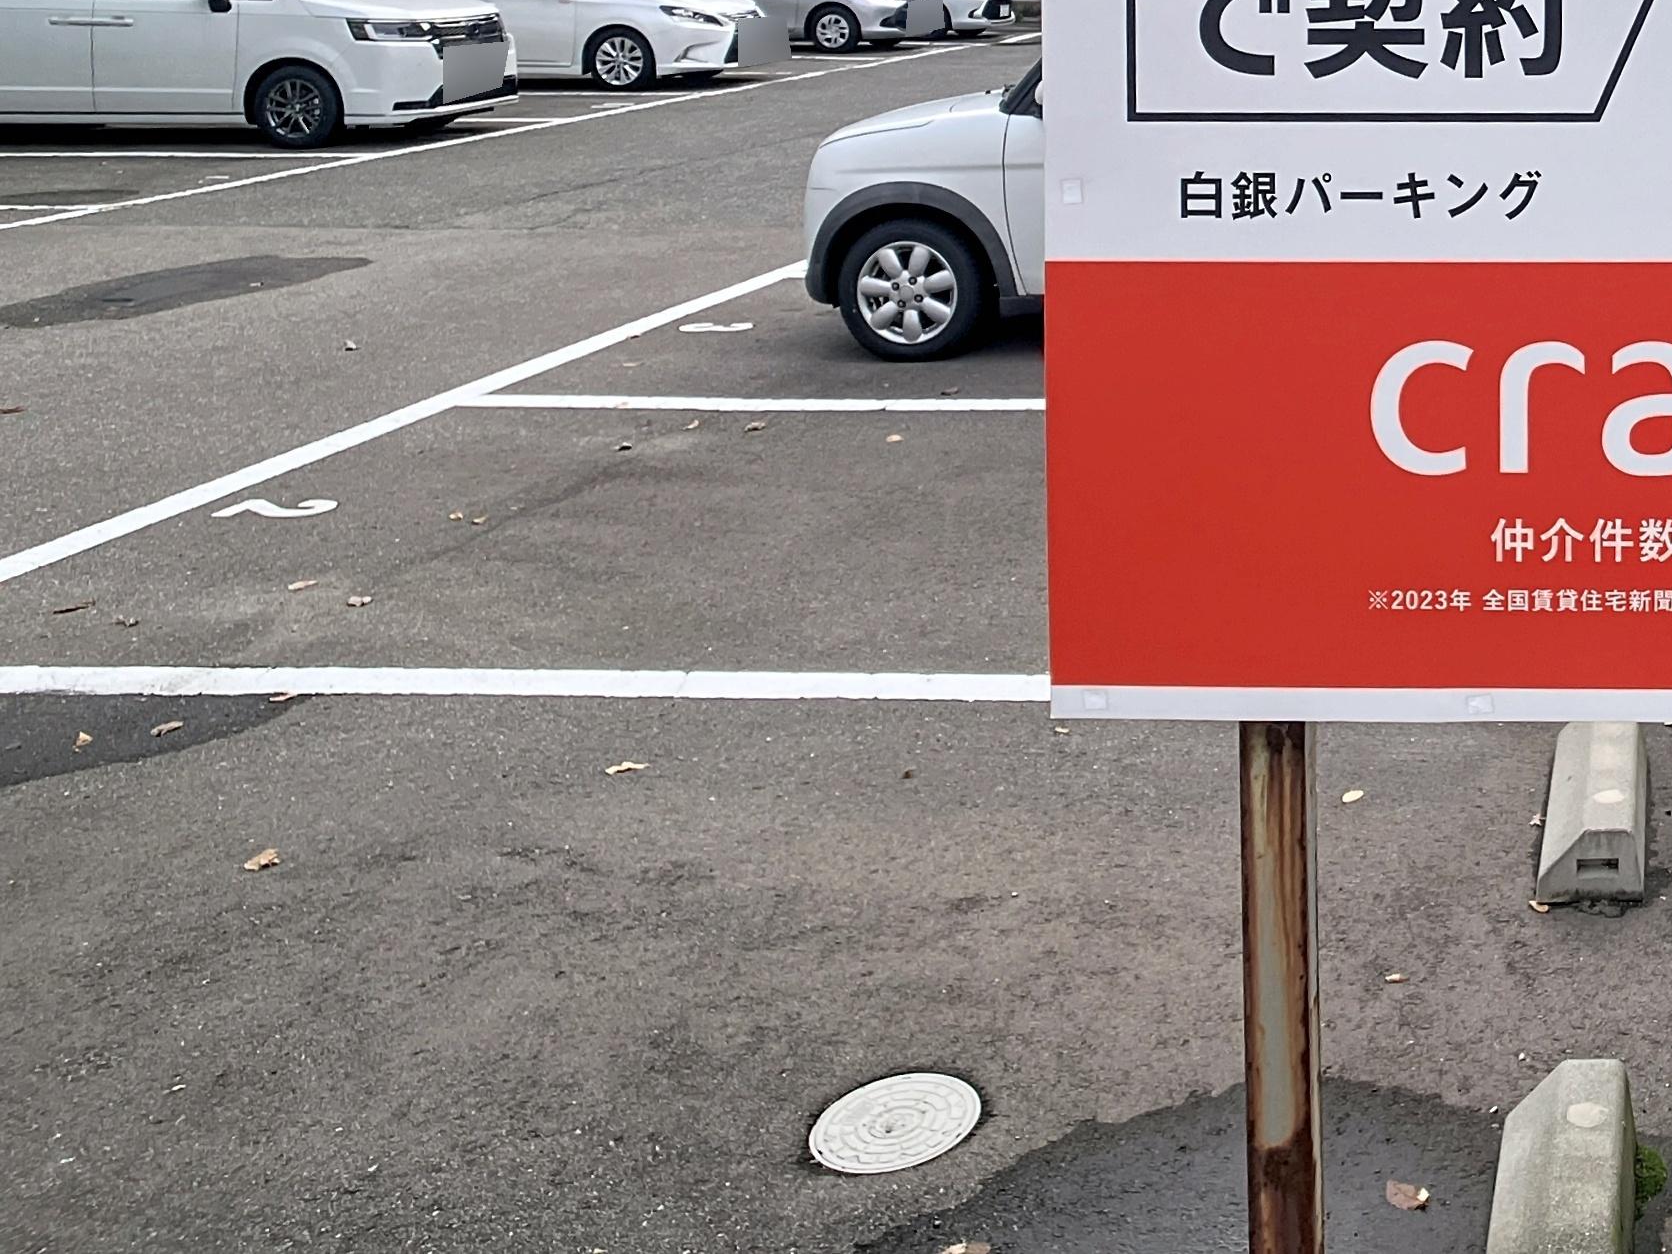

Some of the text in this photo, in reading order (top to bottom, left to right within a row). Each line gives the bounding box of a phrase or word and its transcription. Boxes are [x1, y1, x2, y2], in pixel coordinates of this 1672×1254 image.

[1180, 170, 1542, 221] 白銀パーキング
